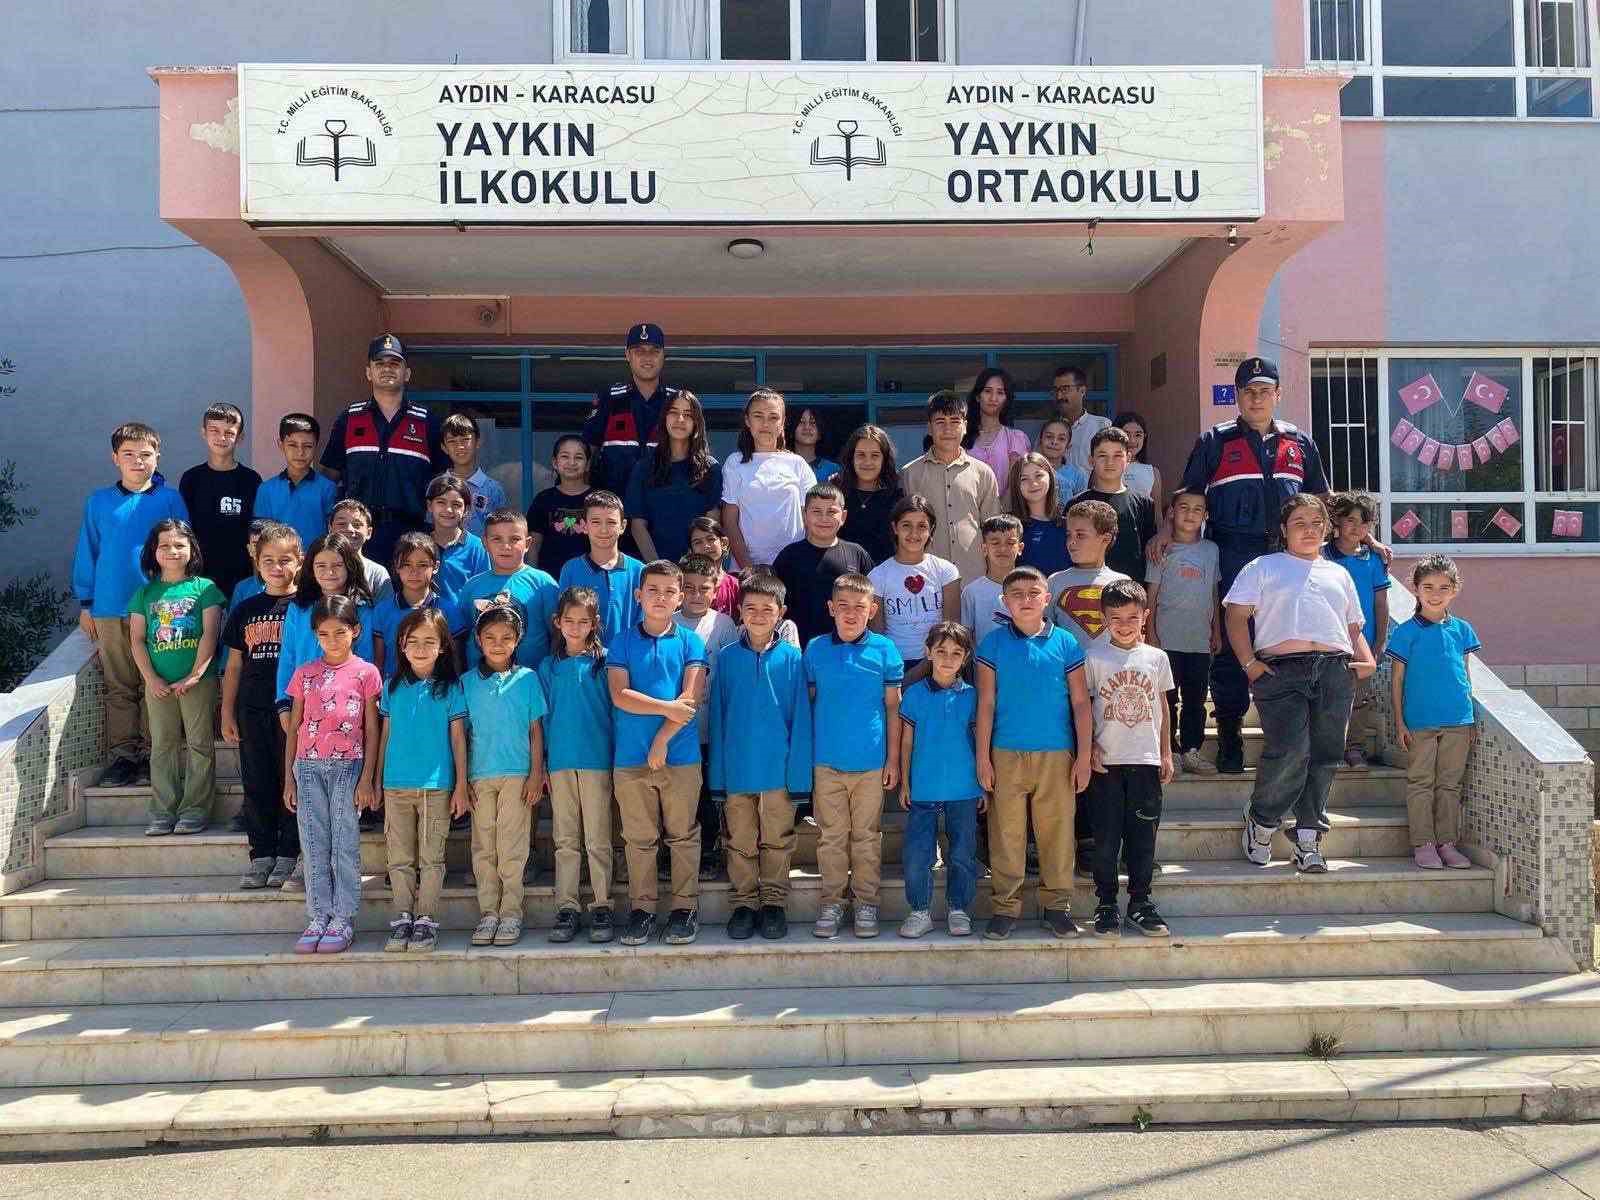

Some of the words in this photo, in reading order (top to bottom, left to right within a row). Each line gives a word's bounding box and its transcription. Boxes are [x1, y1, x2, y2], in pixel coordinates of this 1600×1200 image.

[438, 84, 508, 104] AYDIN
[532, 84, 655, 104] KARACASU
[946, 85, 1014, 104] AYDIN
[1037, 85, 1155, 105] KARACASU
[436, 121, 595, 157] YAYKIN
[944, 121, 1097, 156] YAYKIN
[439, 161, 656, 205] İLKOKULU
[947, 169, 1200, 204] ORTAOKULU
[220, 496, 242, 514] 65
